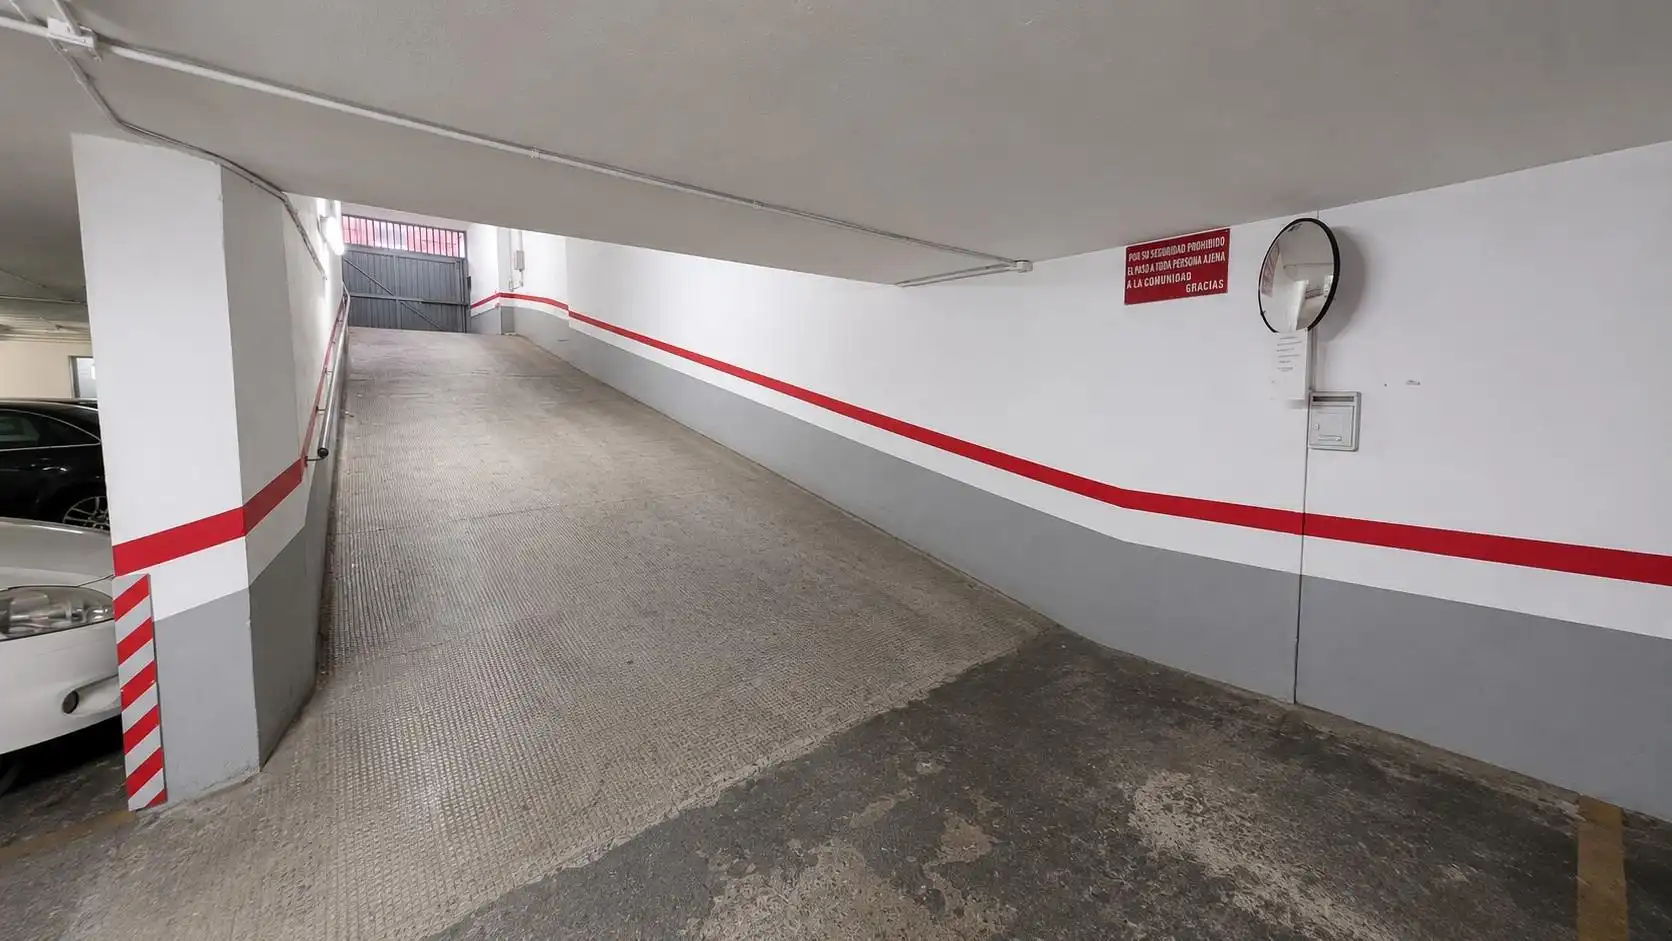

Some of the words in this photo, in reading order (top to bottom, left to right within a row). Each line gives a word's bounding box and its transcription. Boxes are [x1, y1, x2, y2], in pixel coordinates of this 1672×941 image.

[1141, 250, 1149, 259] SU
[1128, 266, 1134, 275] EL
[1135, 264, 1149, 274] PASO
[1150, 263, 1156, 273] A
[1156, 260, 1172, 272] TODA
[1172, 255, 1202, 269] PERSONA
[1203, 252, 1225, 264] AJENA
[1126, 280, 1132, 289] A
[1134, 279, 1143, 289] LA
[1144, 271, 1192, 287] COMUNIDAD
[1186, 280, 1224, 293] GRACIAS
